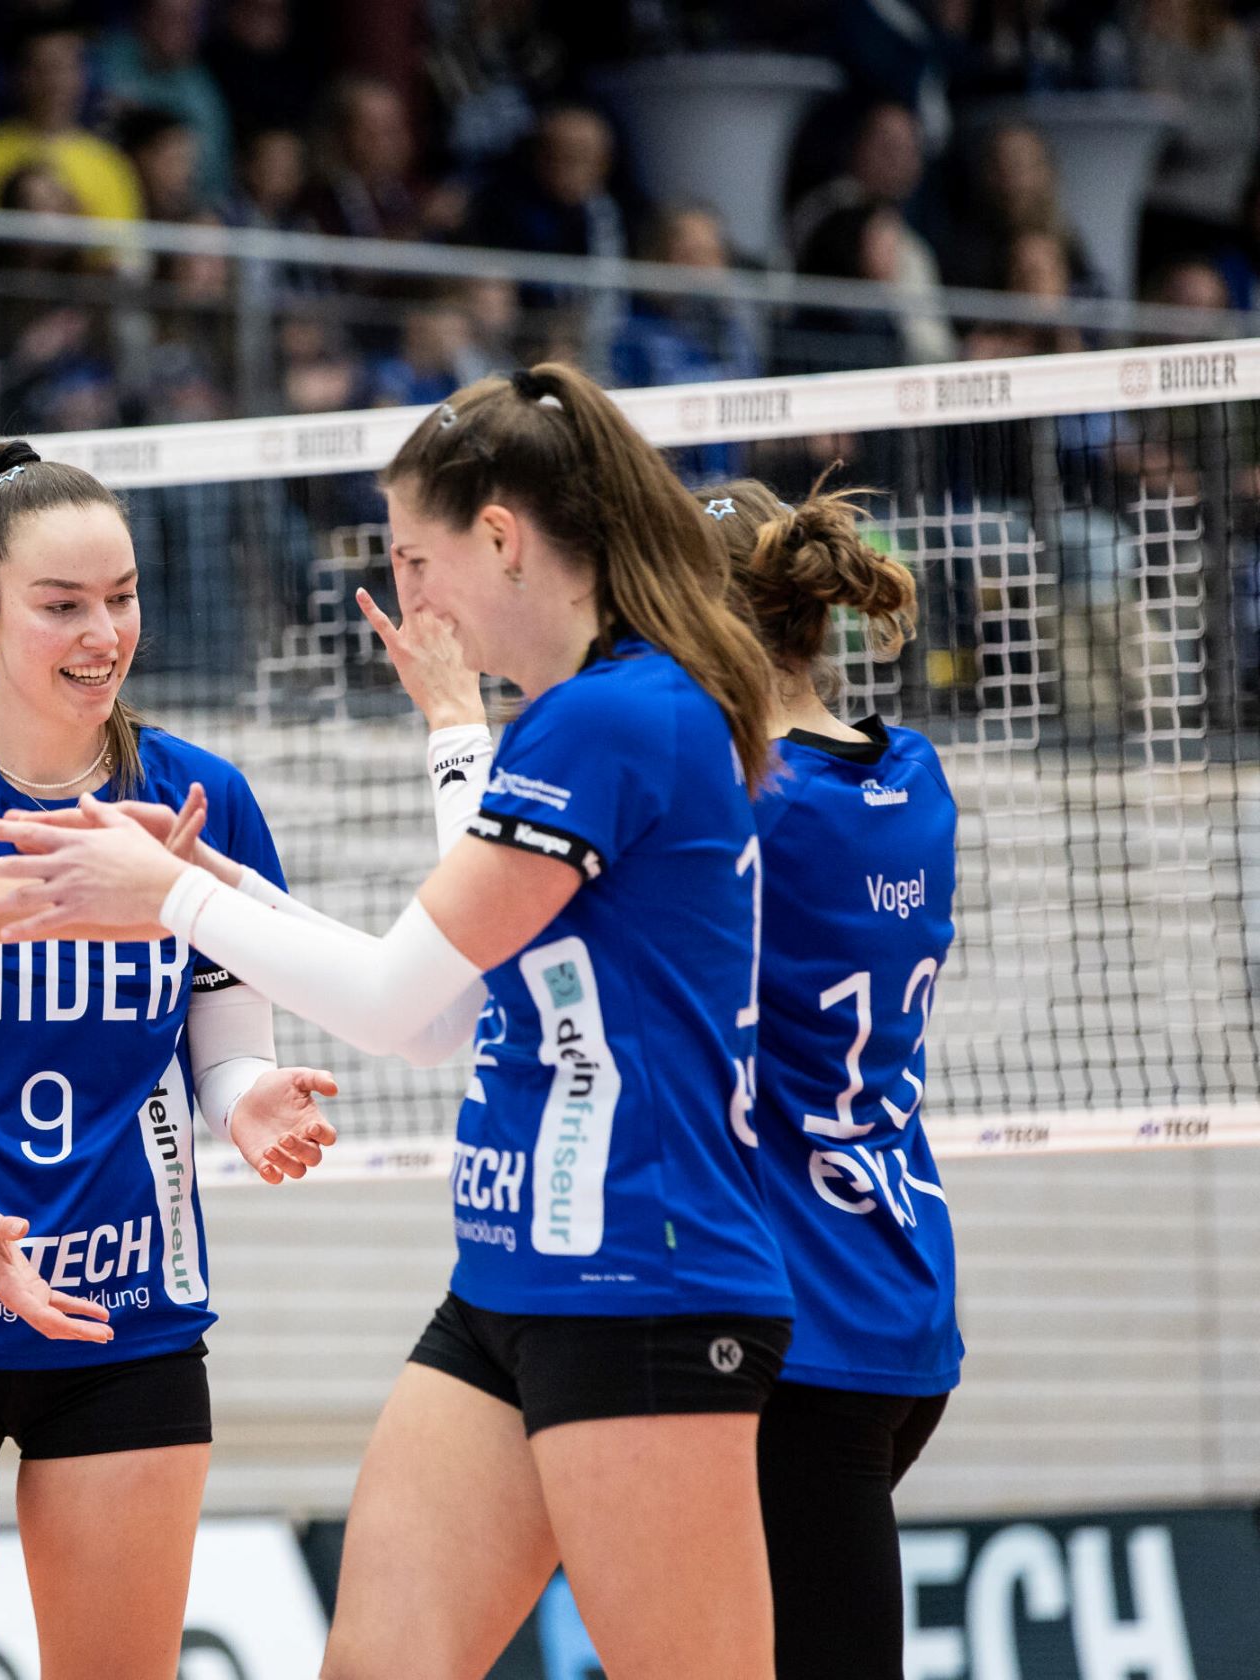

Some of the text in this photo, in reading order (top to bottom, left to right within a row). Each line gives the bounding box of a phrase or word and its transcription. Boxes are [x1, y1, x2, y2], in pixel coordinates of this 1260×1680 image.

[936, 372, 1012, 408] BINDER
[1160, 353, 1238, 391] BINDER
[866, 867, 926, 919] Vogel
[192, 969, 229, 988] mpa
[21, 1071, 73, 1165] 9
[552, 1018, 600, 1245] deinfriseur
